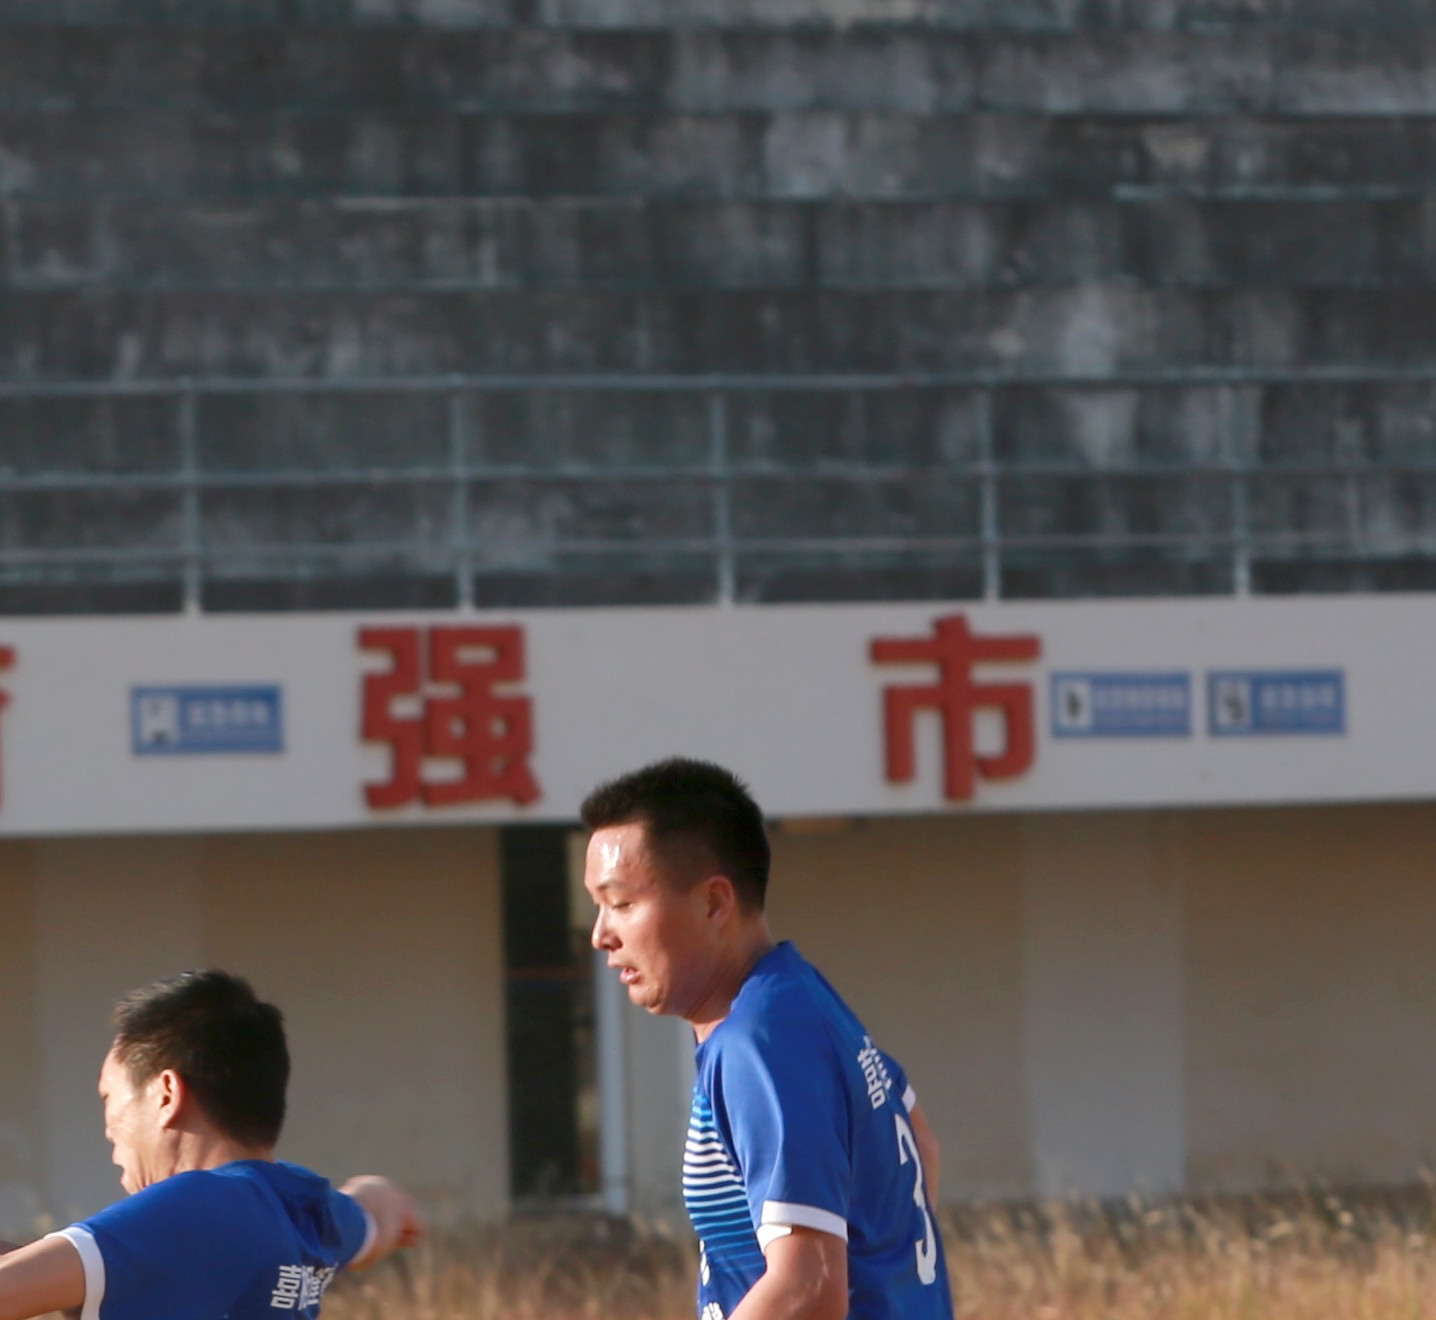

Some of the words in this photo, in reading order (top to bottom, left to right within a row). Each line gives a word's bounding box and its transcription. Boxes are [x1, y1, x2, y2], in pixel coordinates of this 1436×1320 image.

[358, 625, 541, 810] 强
[870, 615, 1041, 802] 市
[895, 1113, 937, 1285] 3
